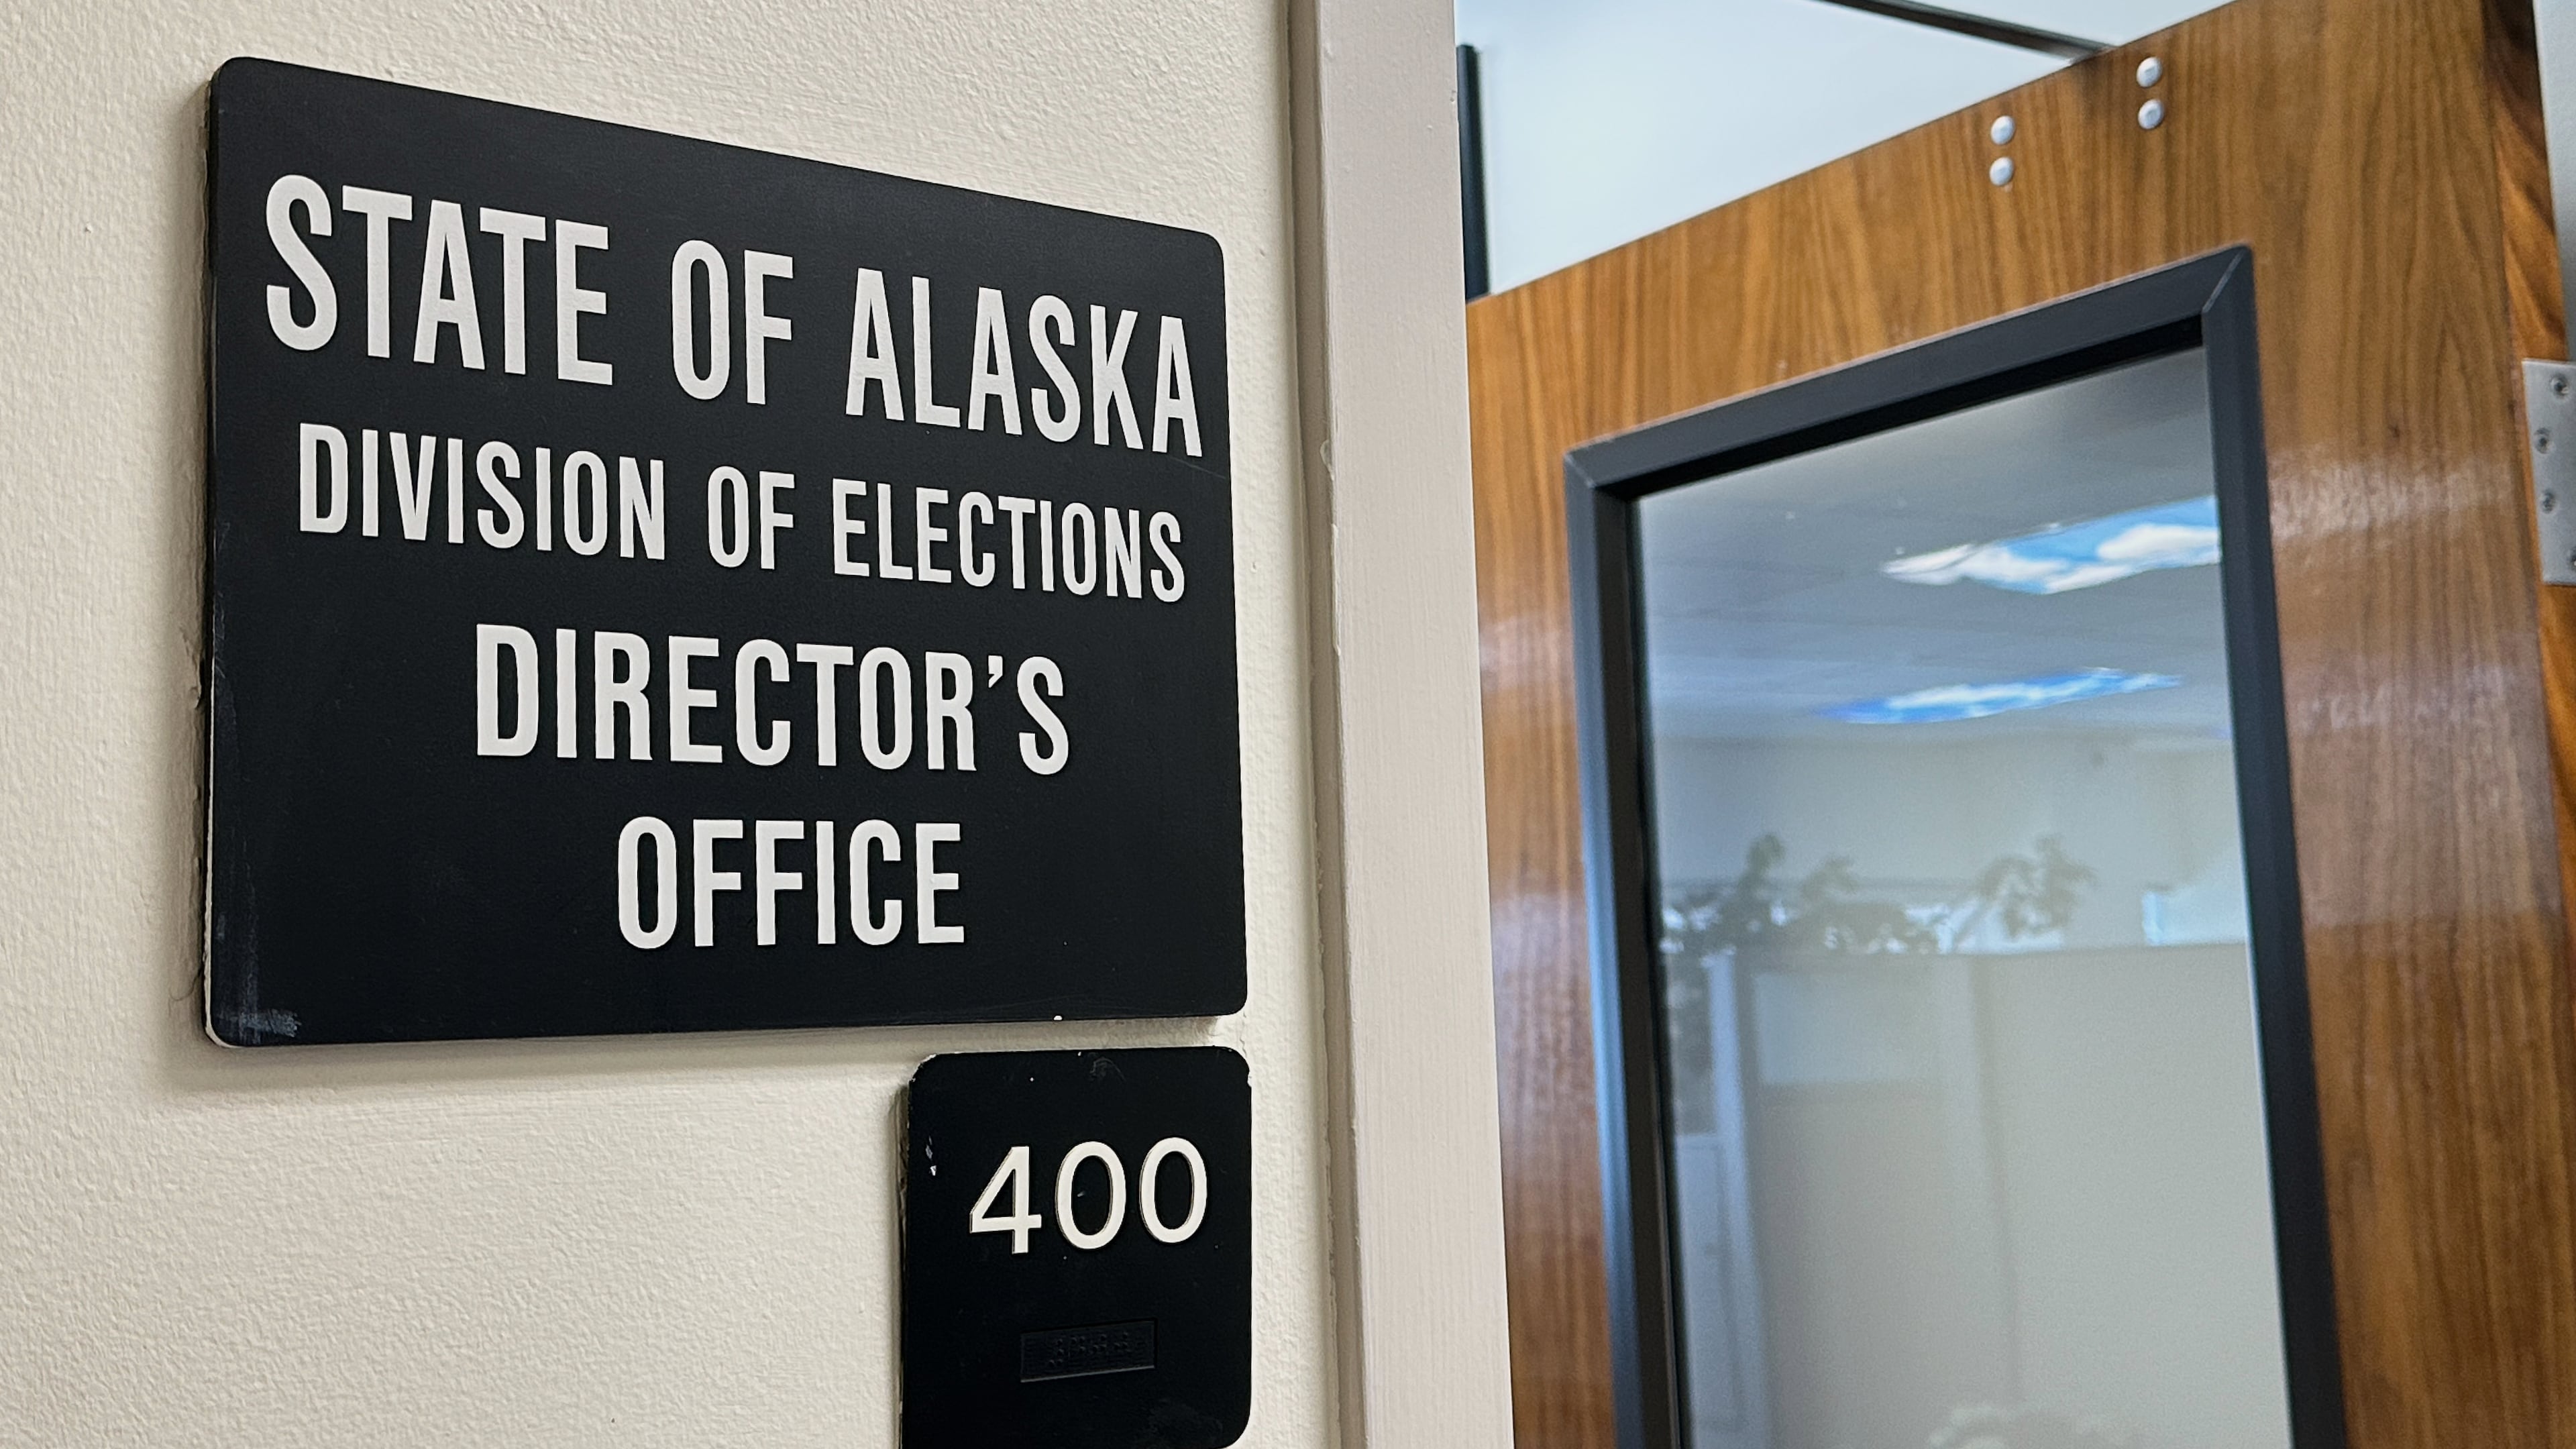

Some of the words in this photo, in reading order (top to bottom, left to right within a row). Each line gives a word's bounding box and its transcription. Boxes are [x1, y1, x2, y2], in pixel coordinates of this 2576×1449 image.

[266, 174, 613, 386] STATE
[672, 239, 794, 405] OF
[845, 268, 1203, 458] ALASKA
[299, 423, 665, 560] DIVISION
[707, 466, 795, 570] OF
[832, 478, 1185, 602] ELECTIONS
[476, 623, 1069, 775] DIRECTOR’S
[617, 816, 965, 949] OFFICE
[969, 1137, 1208, 1254] 400
